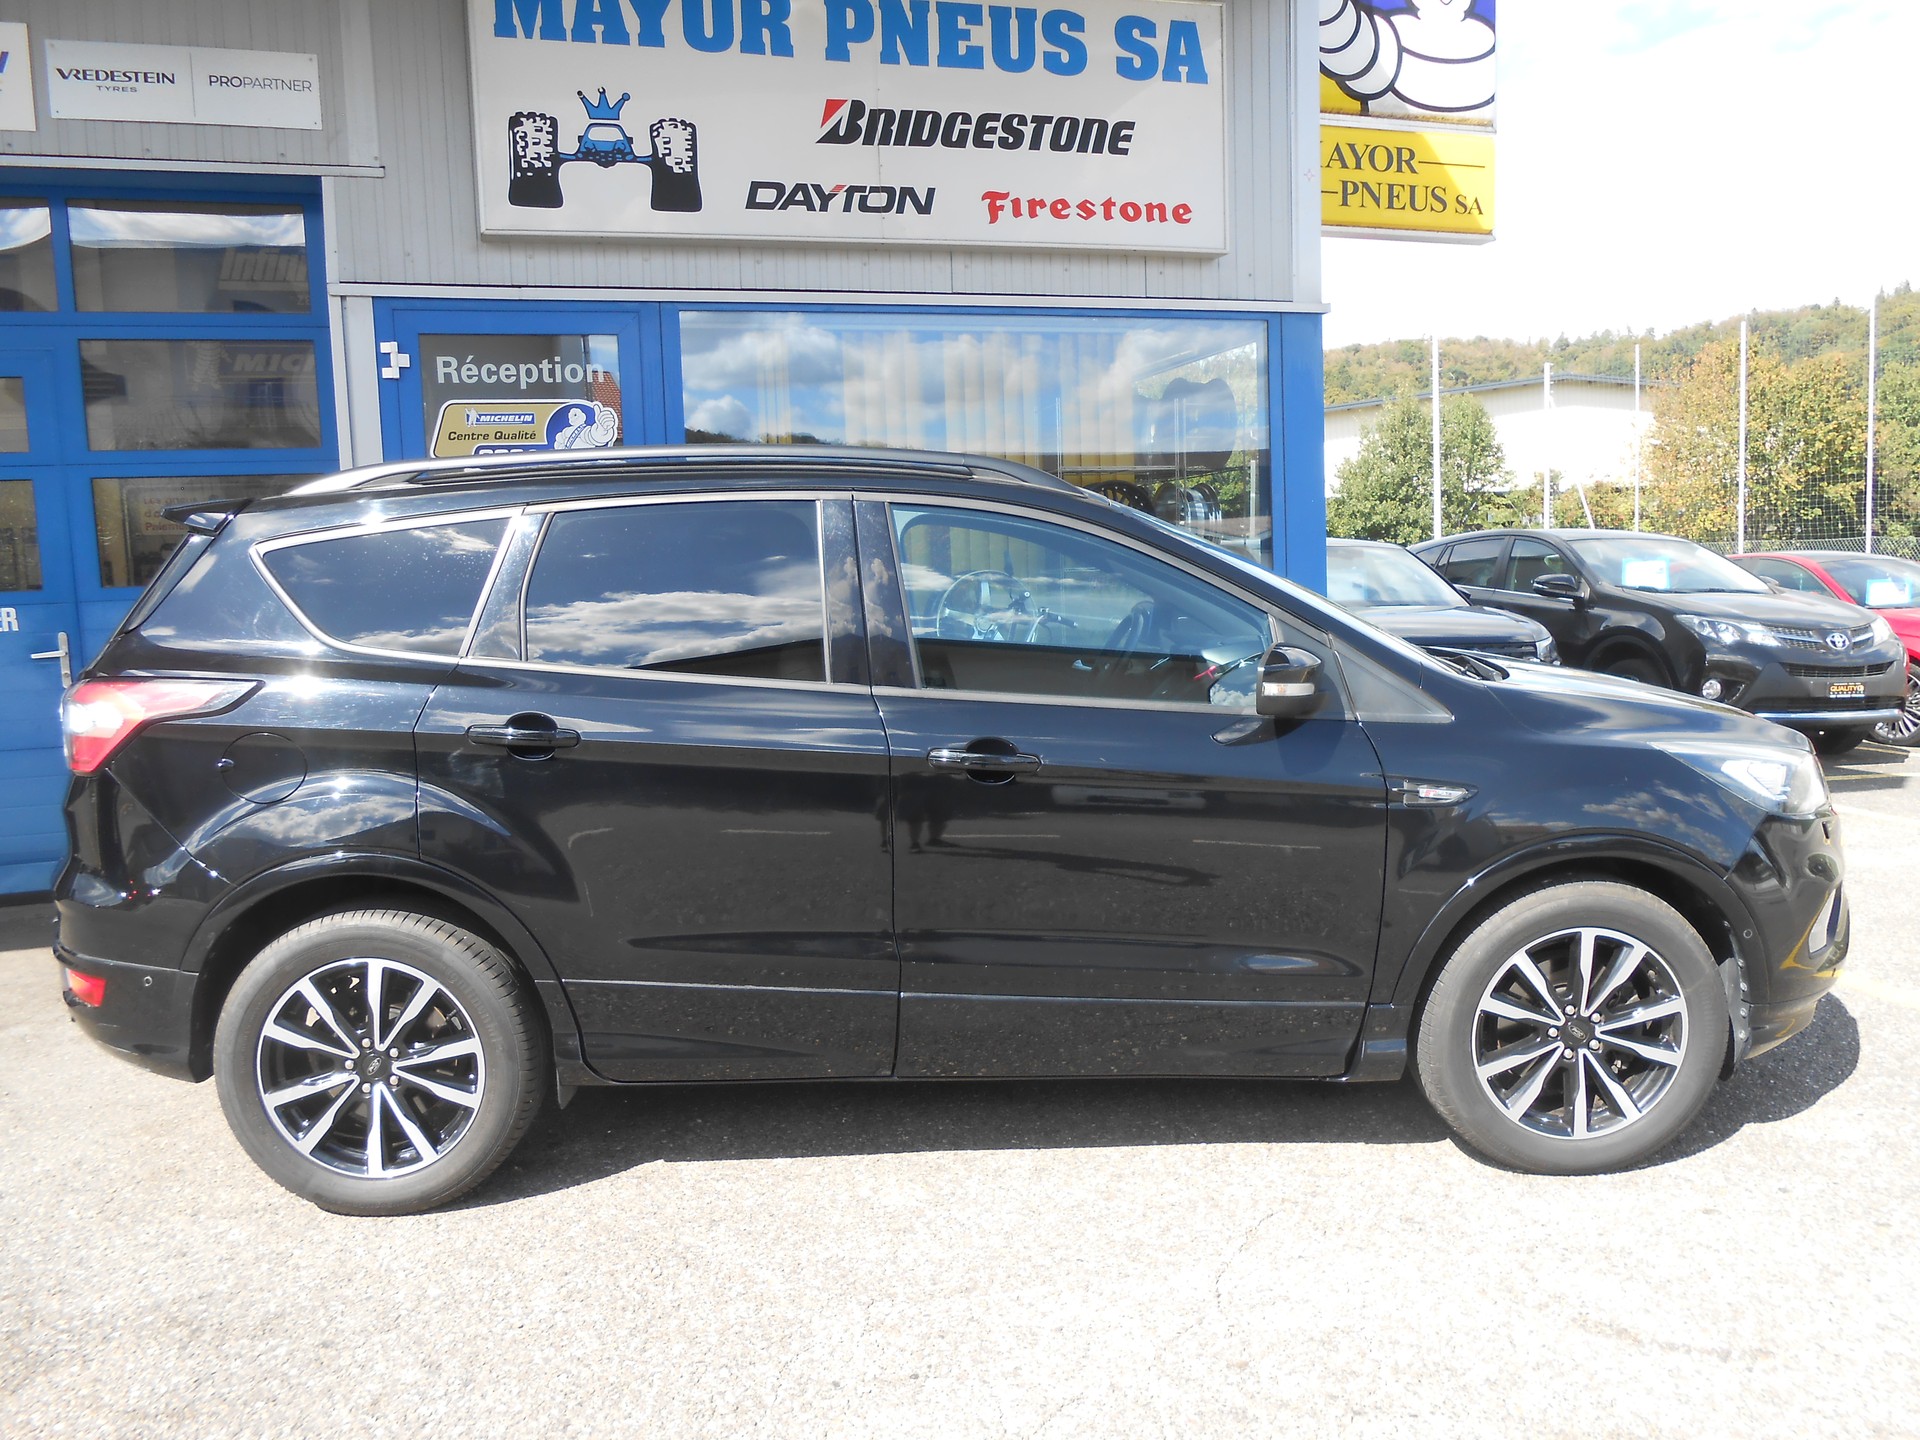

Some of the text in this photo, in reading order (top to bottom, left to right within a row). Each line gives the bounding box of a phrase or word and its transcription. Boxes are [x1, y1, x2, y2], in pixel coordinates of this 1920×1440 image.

[824, 0, 1088, 76] PNEUS
[1114, 14, 1209, 84] SA
[56, 68, 313, 92] VREDESTEIN PROPARTNER
[96, 85, 138, 93] TYRES
[816, 98, 1136, 156] BRIDGESTONE
[1320, 140, 1420, 175] AYOR
[745, 180, 937, 216] DAYTON
[980, 190, 1193, 225] Firestone
[1338, 179, 1484, 215] PNEUS SA
[436, 355, 605, 390] Réception
[448, 430, 537, 441] Centre Qualité
[479, 414, 534, 423] MICHELIN
